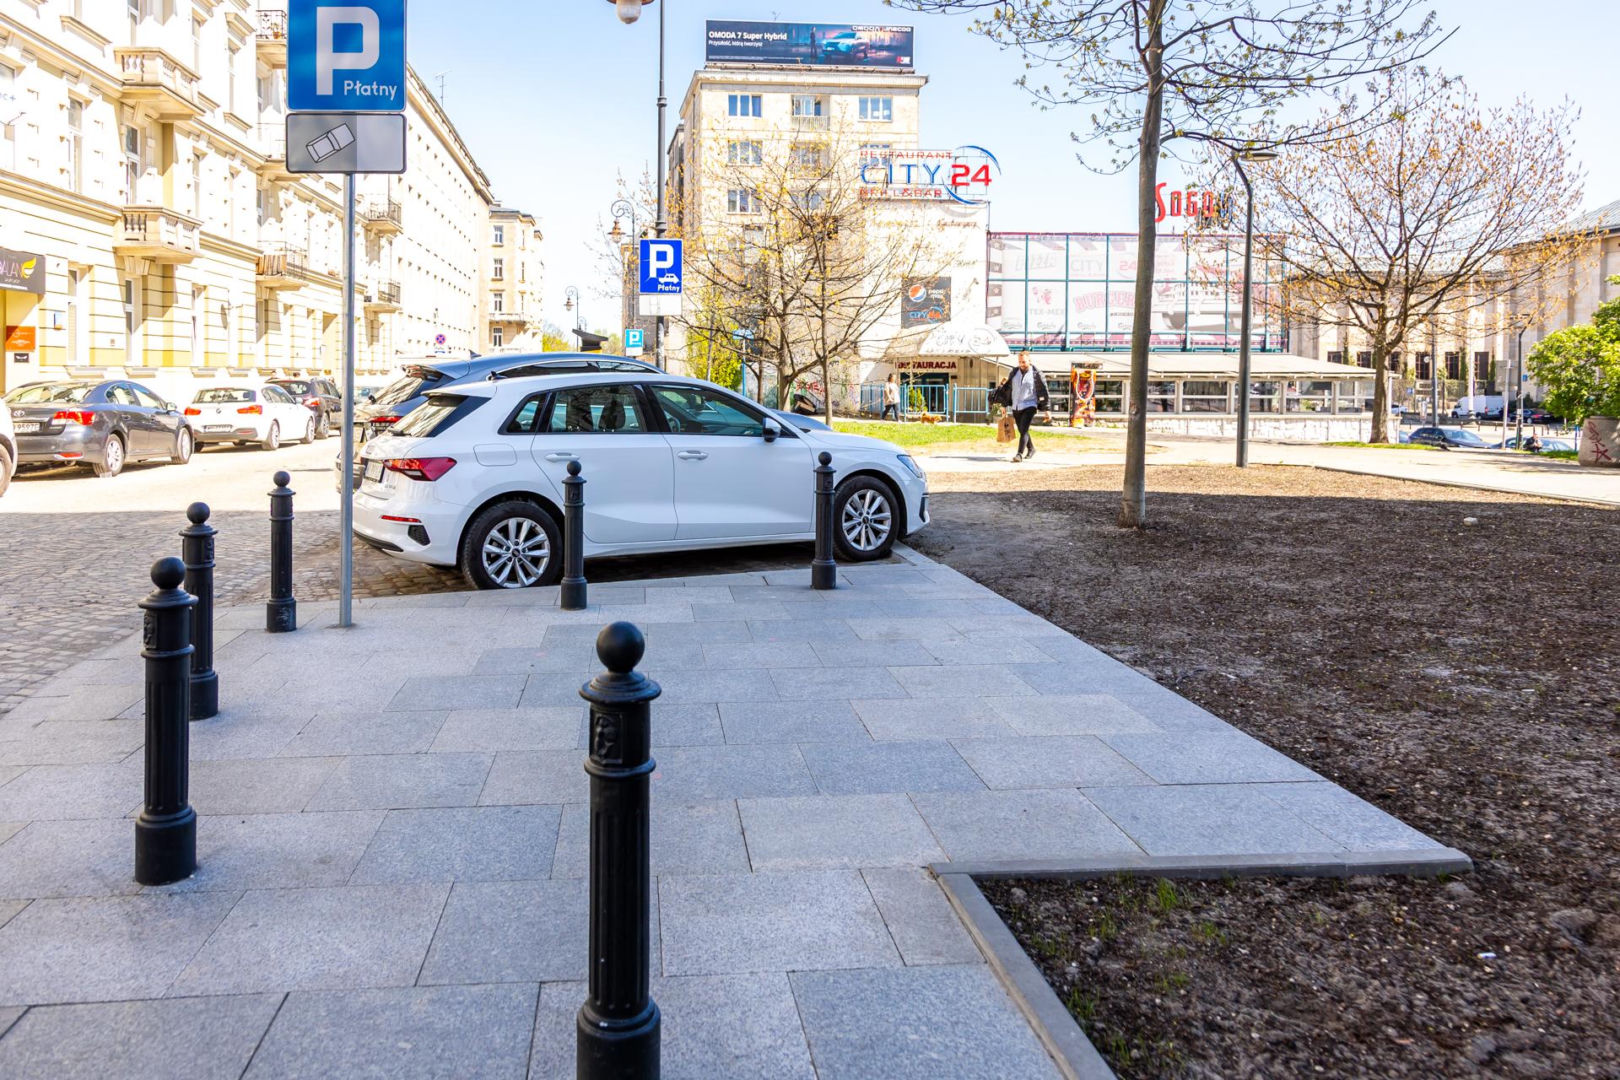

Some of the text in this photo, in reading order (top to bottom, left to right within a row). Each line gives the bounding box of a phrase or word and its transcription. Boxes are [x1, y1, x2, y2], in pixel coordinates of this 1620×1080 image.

[708, 31, 736, 39] OMODA
[743, 32, 763, 41] Super
[764, 33, 788, 41] Hybrid
[316, 6, 380, 96] P
[344, 80, 398, 101] Płatny
[860, 163, 992, 186] CITY 24
[649, 244, 674, 278] P
[629, 331, 639, 345] P
